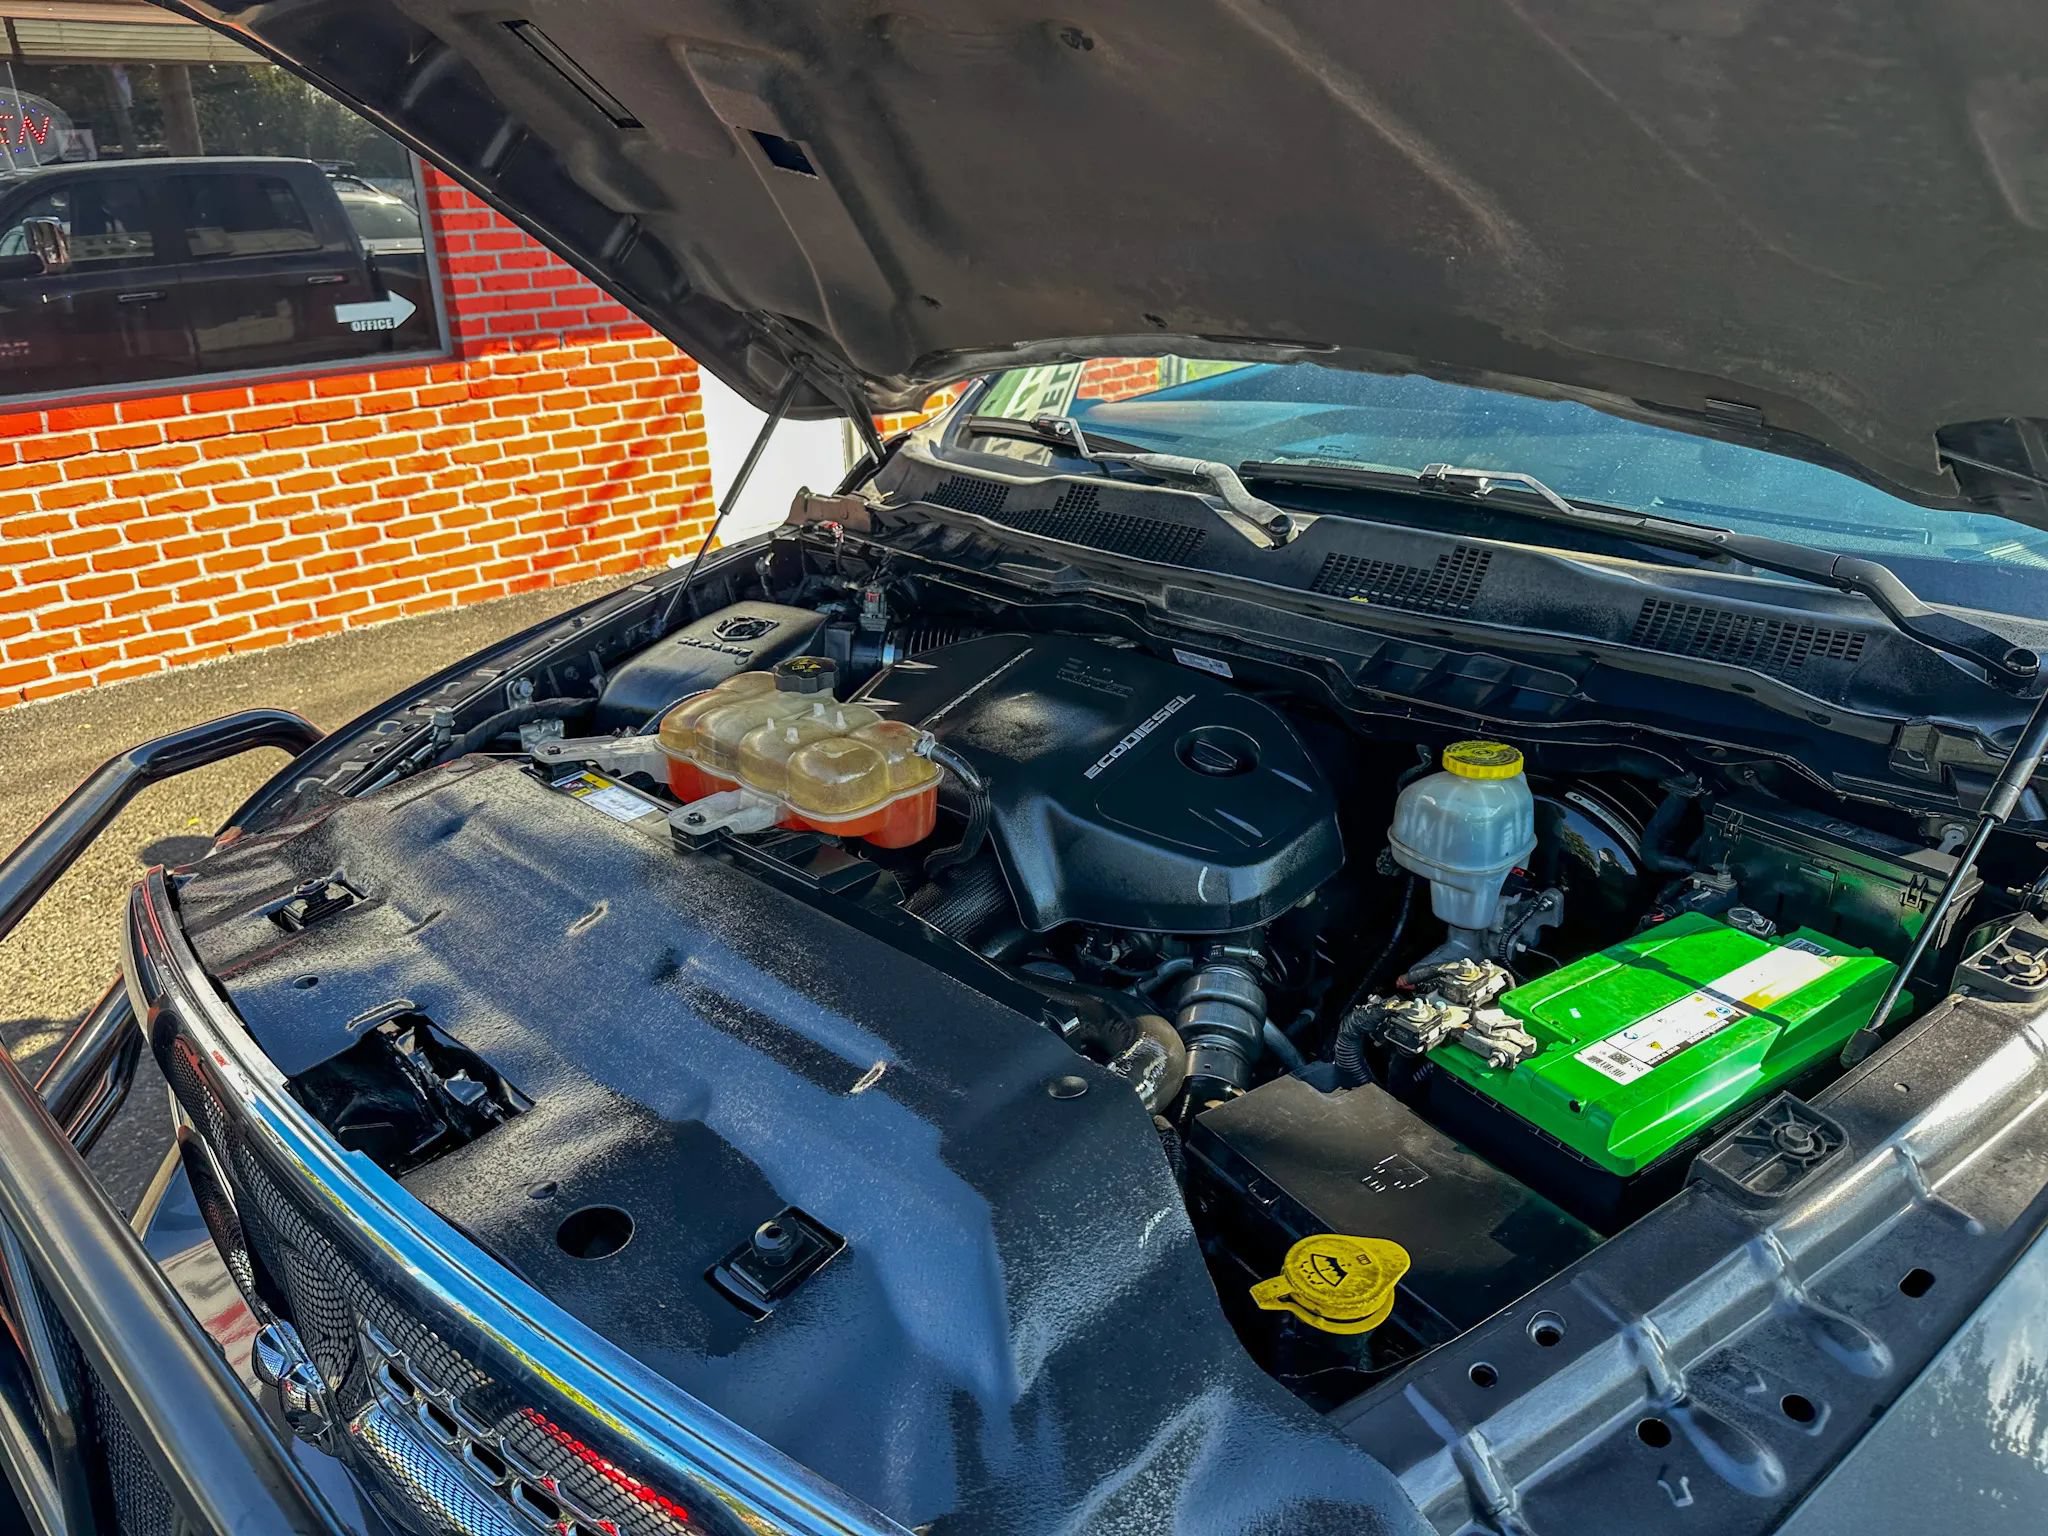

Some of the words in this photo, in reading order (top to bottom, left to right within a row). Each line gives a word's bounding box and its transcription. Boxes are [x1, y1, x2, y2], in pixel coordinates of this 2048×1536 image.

[351, 318, 394, 332] OFFICE
[677, 637, 754, 657] RAM
[1083, 694, 1197, 780] ECODIESEL
